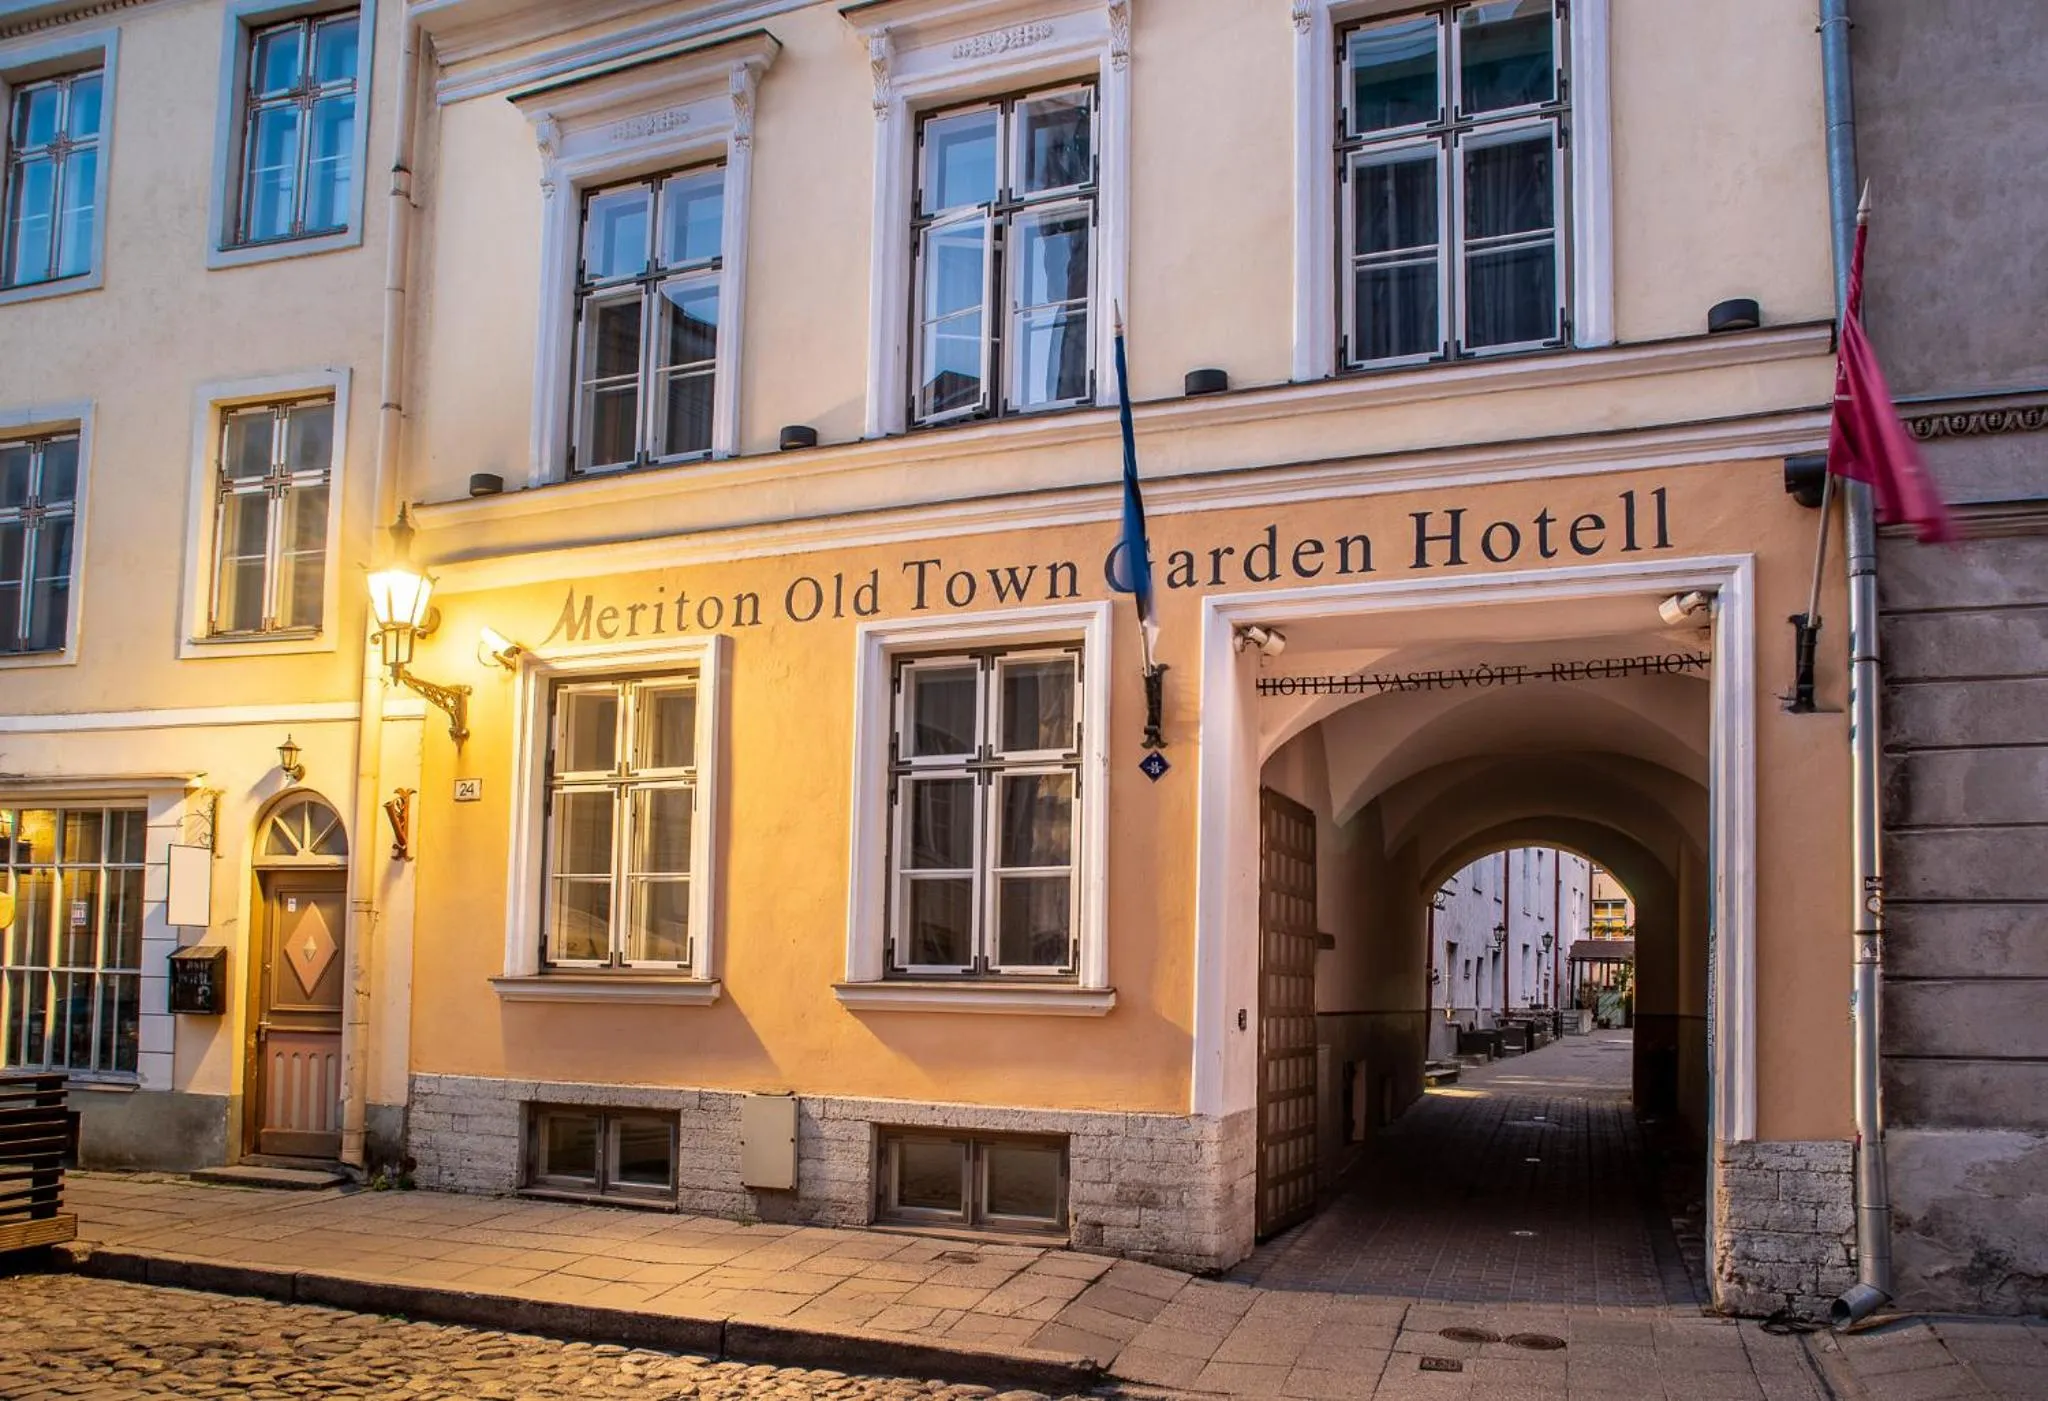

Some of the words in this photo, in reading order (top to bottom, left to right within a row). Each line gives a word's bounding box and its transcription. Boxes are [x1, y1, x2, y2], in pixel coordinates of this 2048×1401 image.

[540, 584, 762, 646] Meriton
[785, 568, 880, 622] Old
[902, 559, 1080, 610] Town
[1104, 524, 1376, 593] Garden
[1409, 487, 1674, 569] Hotell
[1260, 674, 1365, 697] HOTELLI
[1551, 651, 1704, 682] RECEPTION
[459, 782, 475, 797] 24
